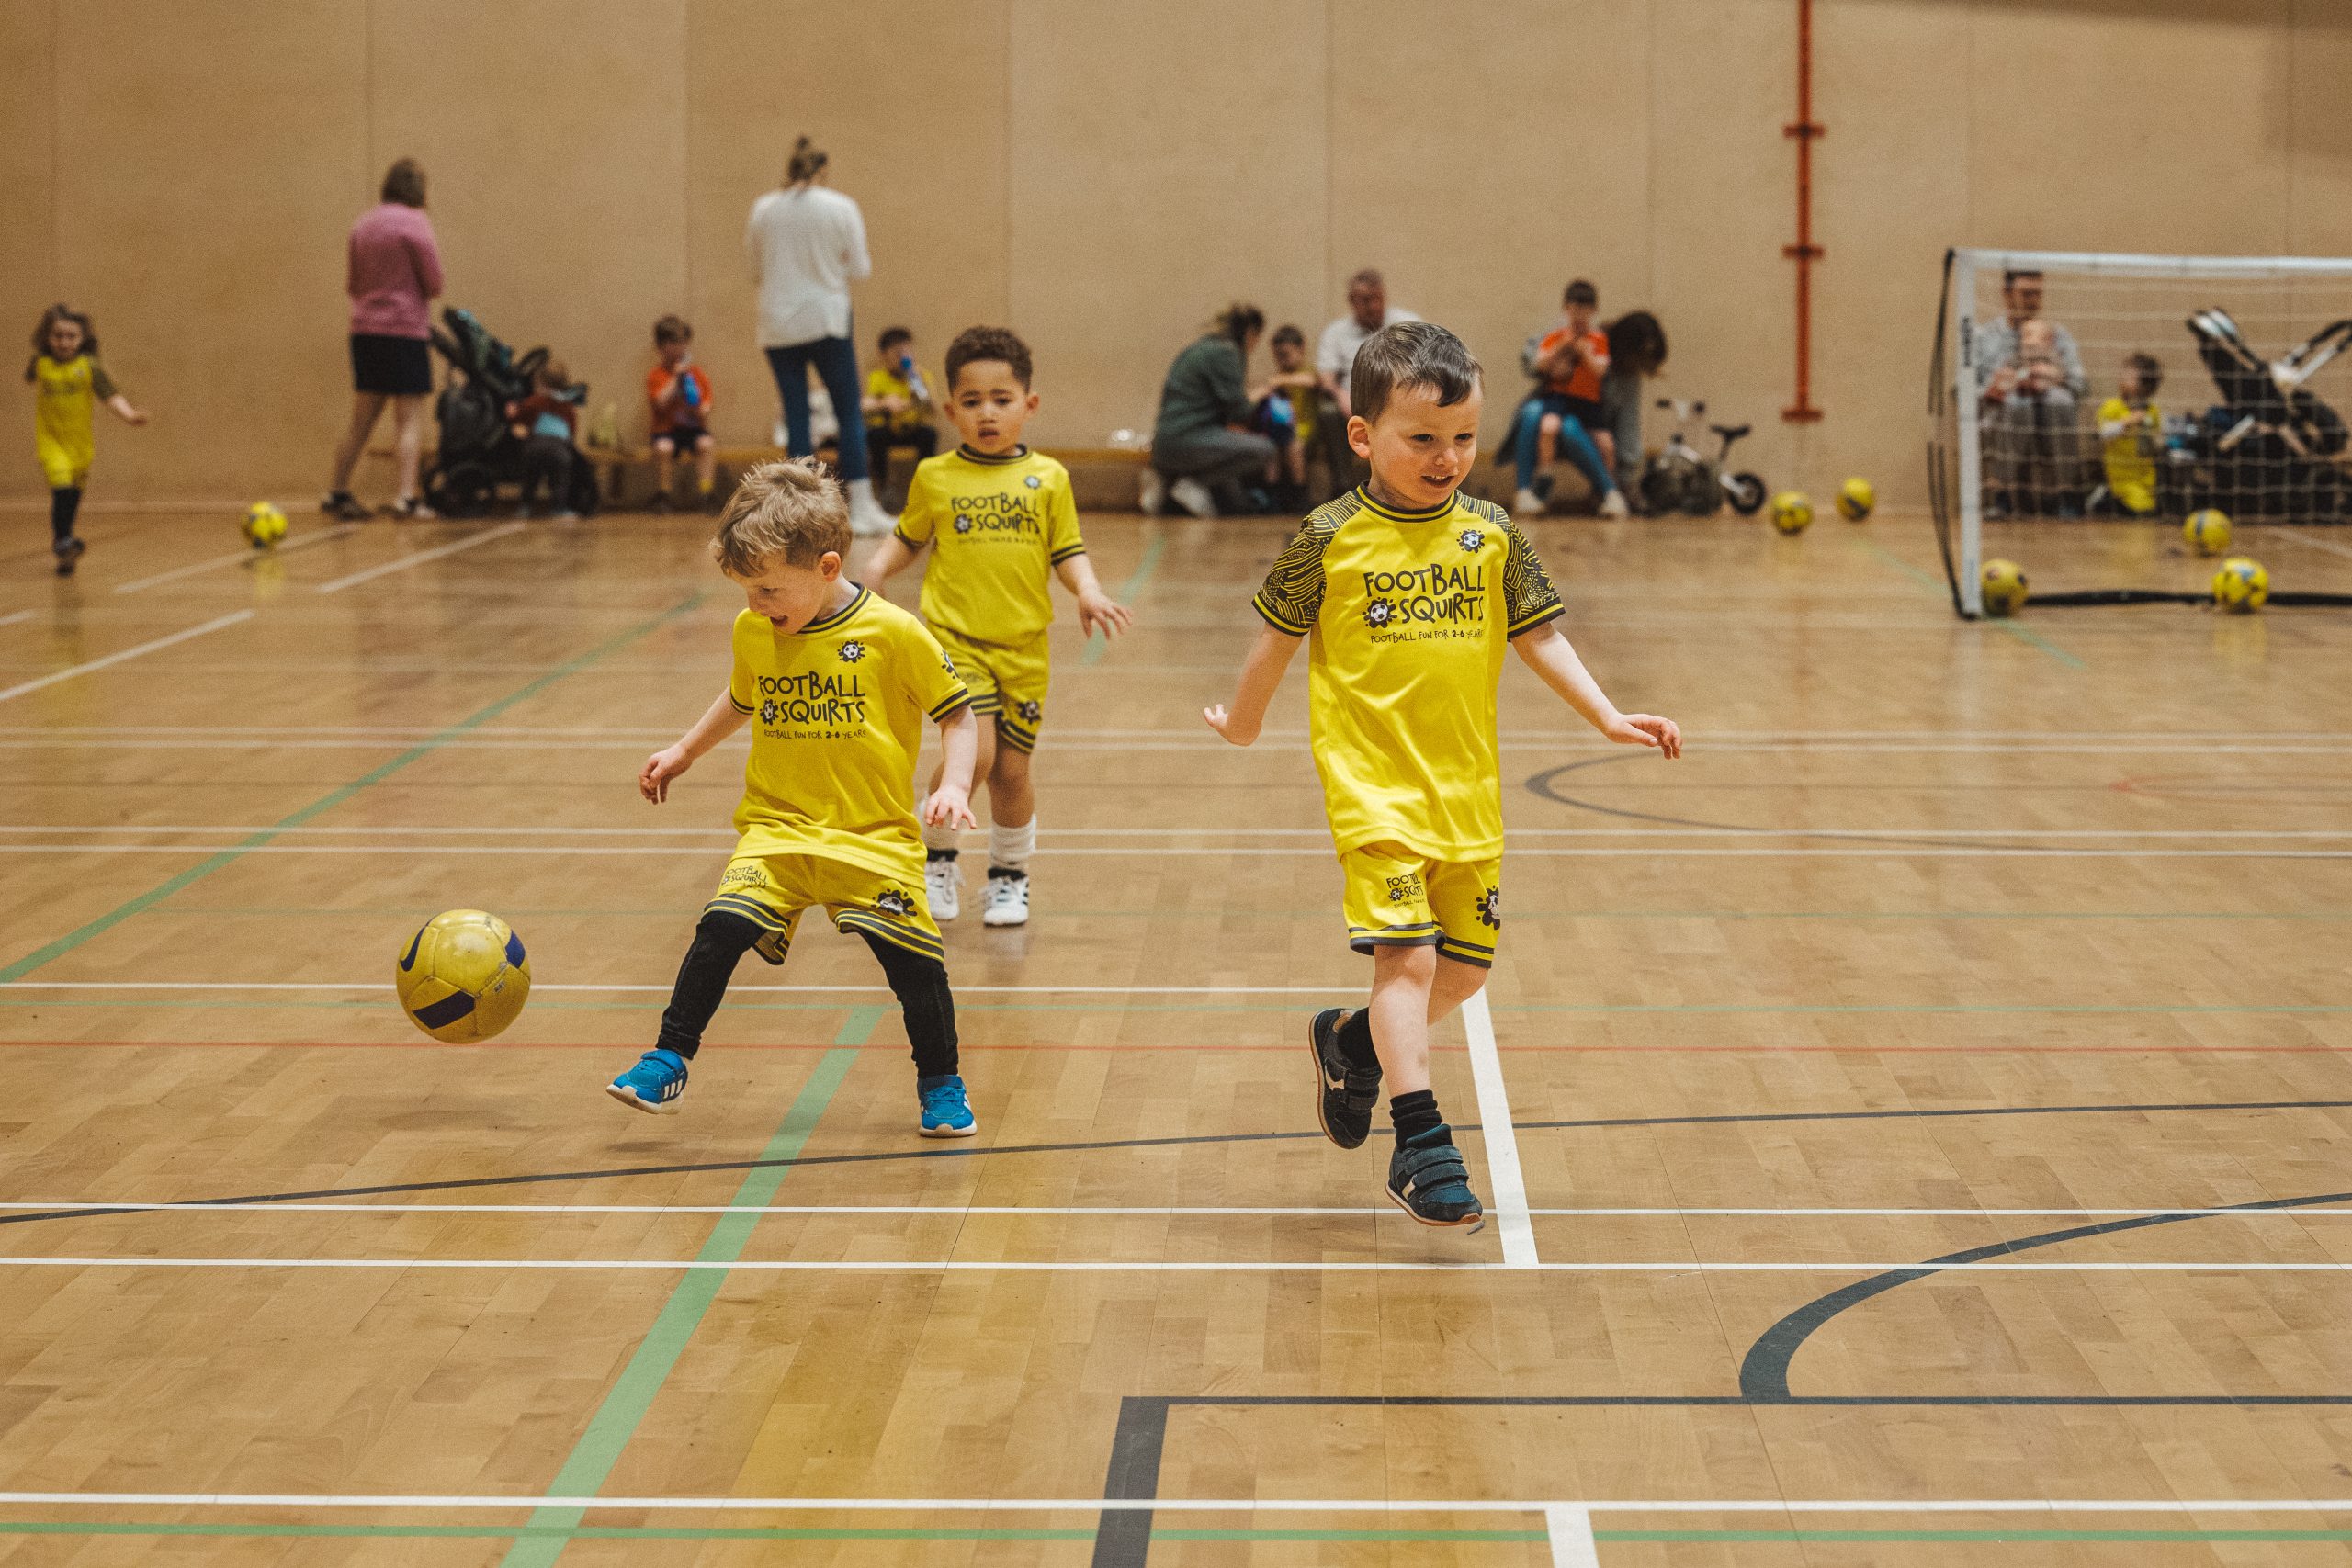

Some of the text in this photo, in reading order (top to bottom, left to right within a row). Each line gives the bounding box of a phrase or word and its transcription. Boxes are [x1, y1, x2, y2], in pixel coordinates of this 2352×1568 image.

[951, 492, 1040, 517] FOOTBALL
[1363, 563, 1485, 597] FOOTBALL
[1399, 593, 1484, 624] SQUIRTS
[1371, 632, 1416, 643] FOOTBALL
[1419, 631, 1432, 639] FUN
[1434, 629, 1449, 640] FOR
[1452, 629, 1464, 638] 2-6
[758, 671, 865, 700] FOOTBALL
[780, 698, 865, 726] SQUIRTS
[794, 730, 806, 739] FUN
[808, 730, 822, 739] FOR
[842, 729, 866, 739] YEARS
[726, 865, 766, 883] OOTBALL
